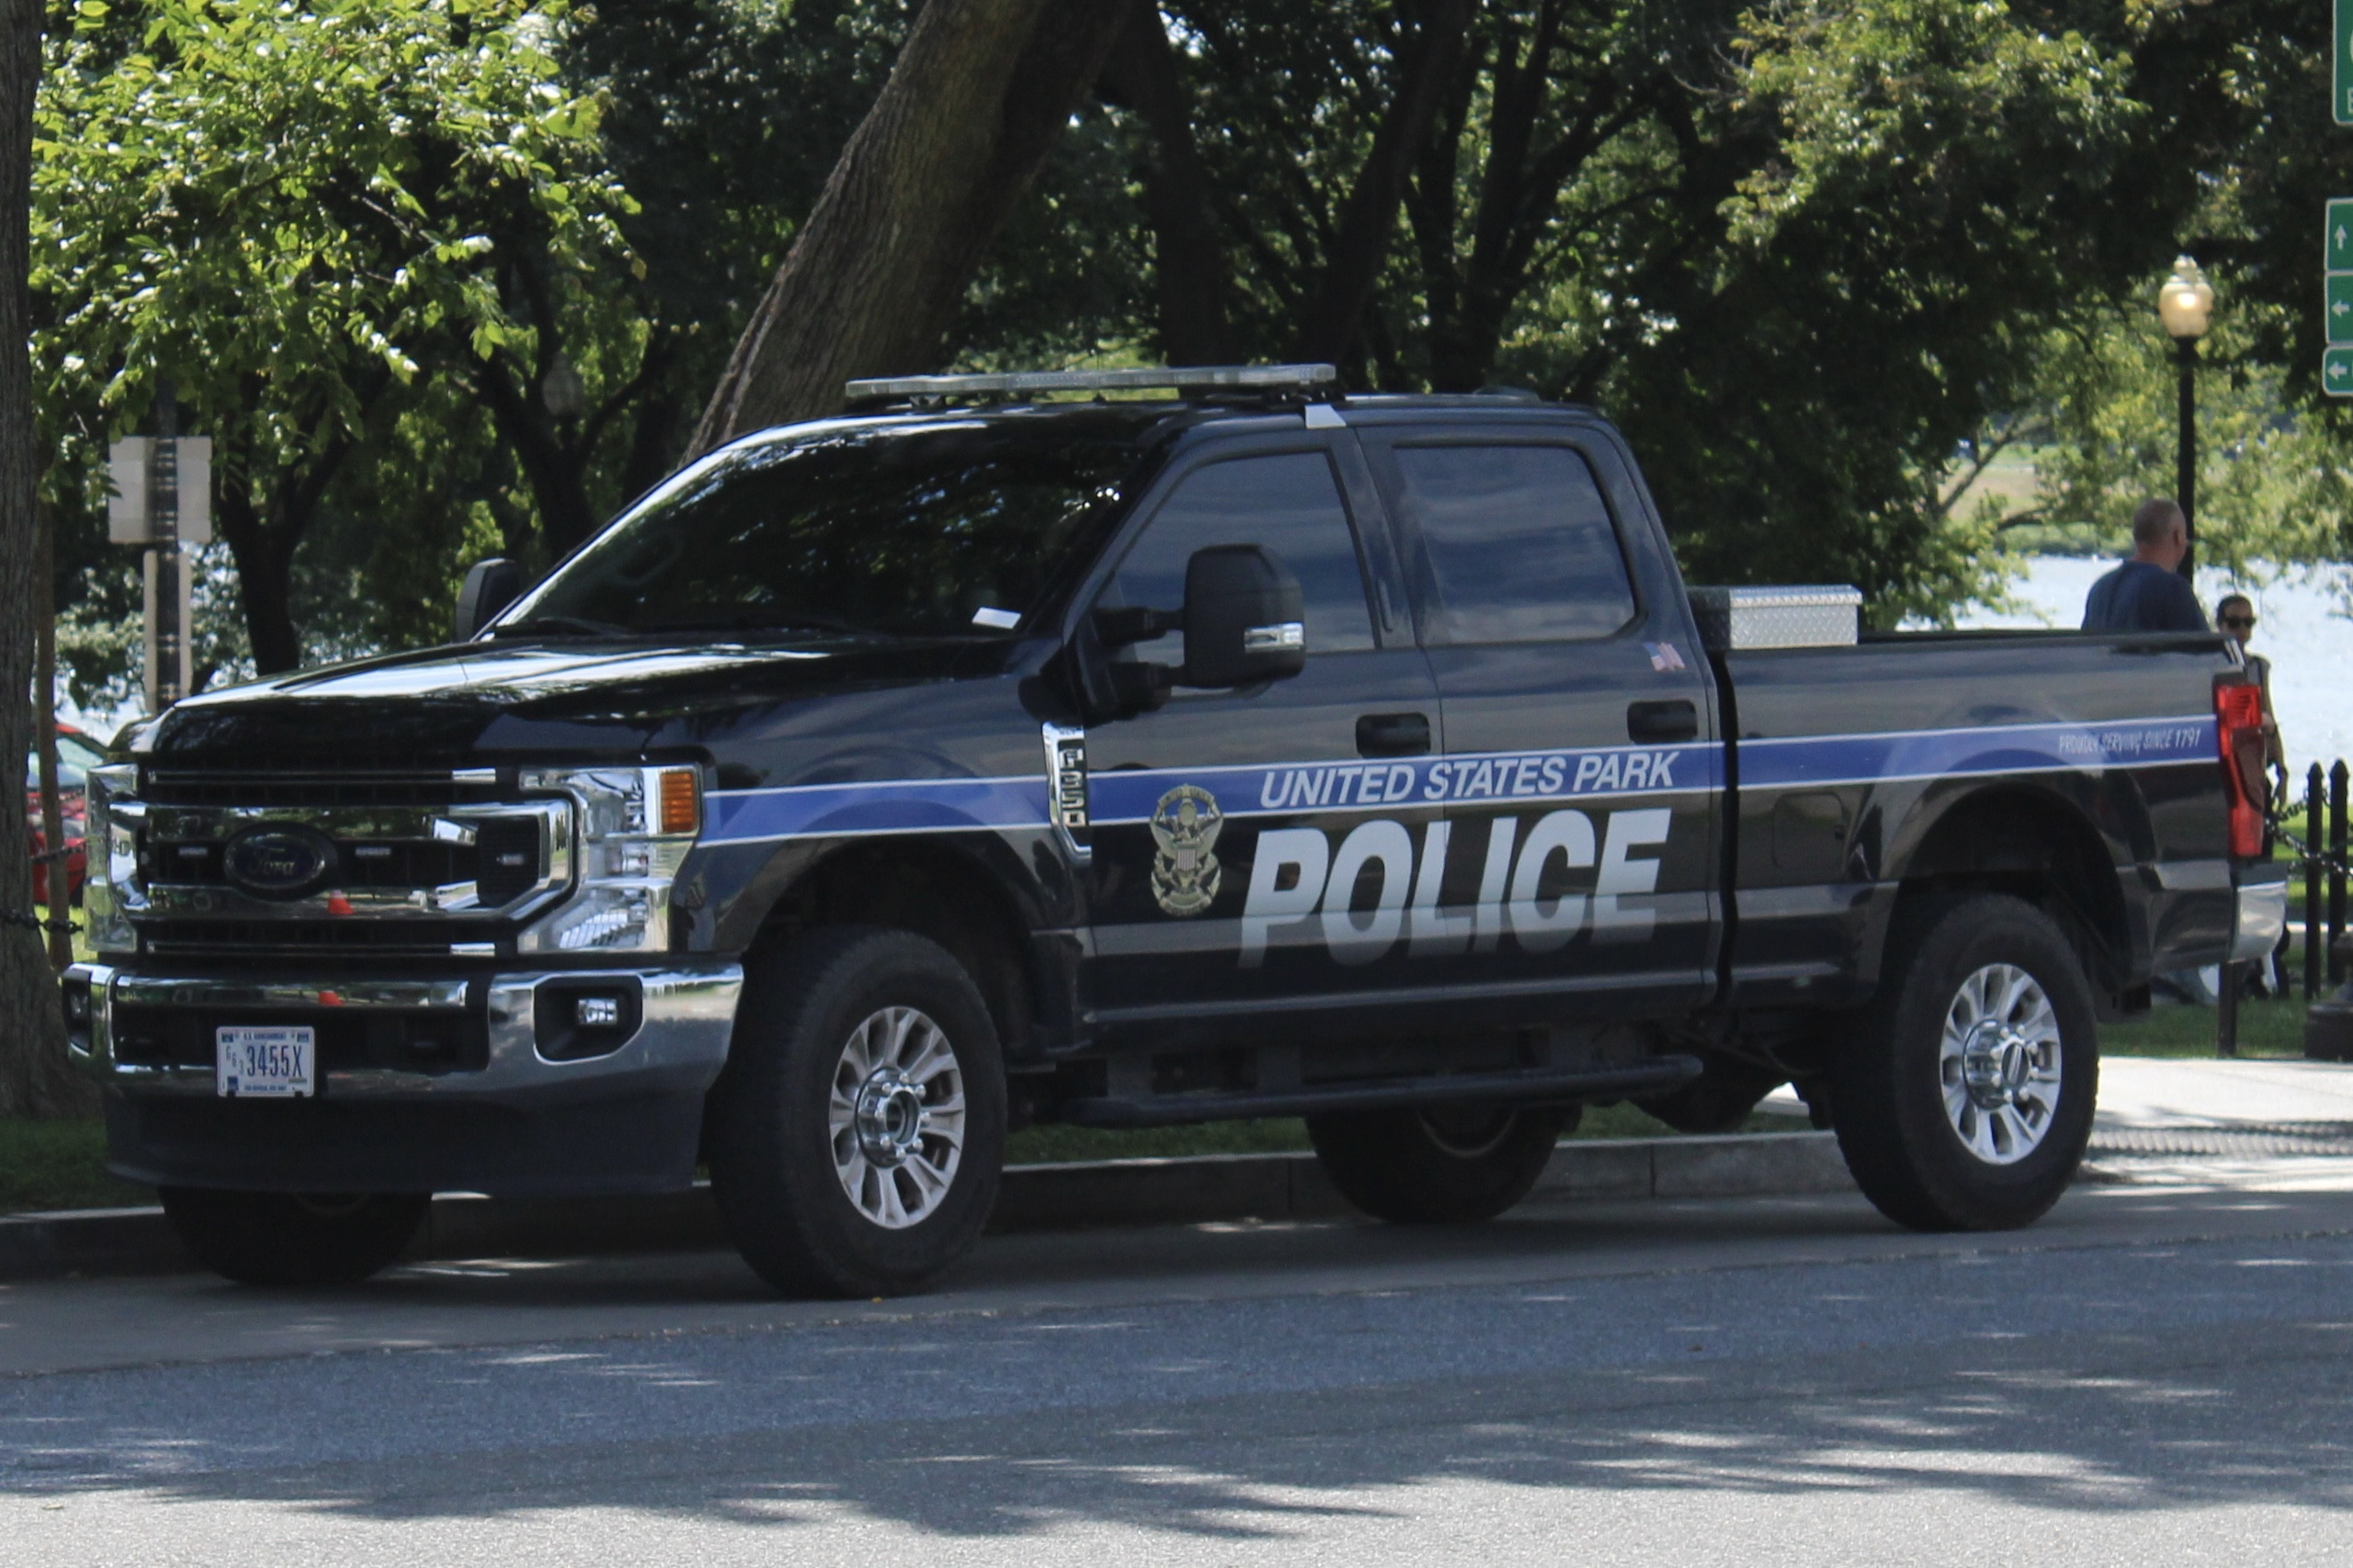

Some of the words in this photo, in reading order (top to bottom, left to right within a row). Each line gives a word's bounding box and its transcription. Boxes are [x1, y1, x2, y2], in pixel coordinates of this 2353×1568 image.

[2101, 730, 2142, 755] SERVING
[2143, 728, 2175, 751] SINCE
[2175, 727, 2202, 748] 1791
[1260, 763, 1415, 808] UNITED
[1423, 755, 1565, 800] STATES
[1572, 751, 1680, 792] PARK
[1237, 808, 1672, 969] POLICE
[246, 1044, 302, 1078] 3455X
